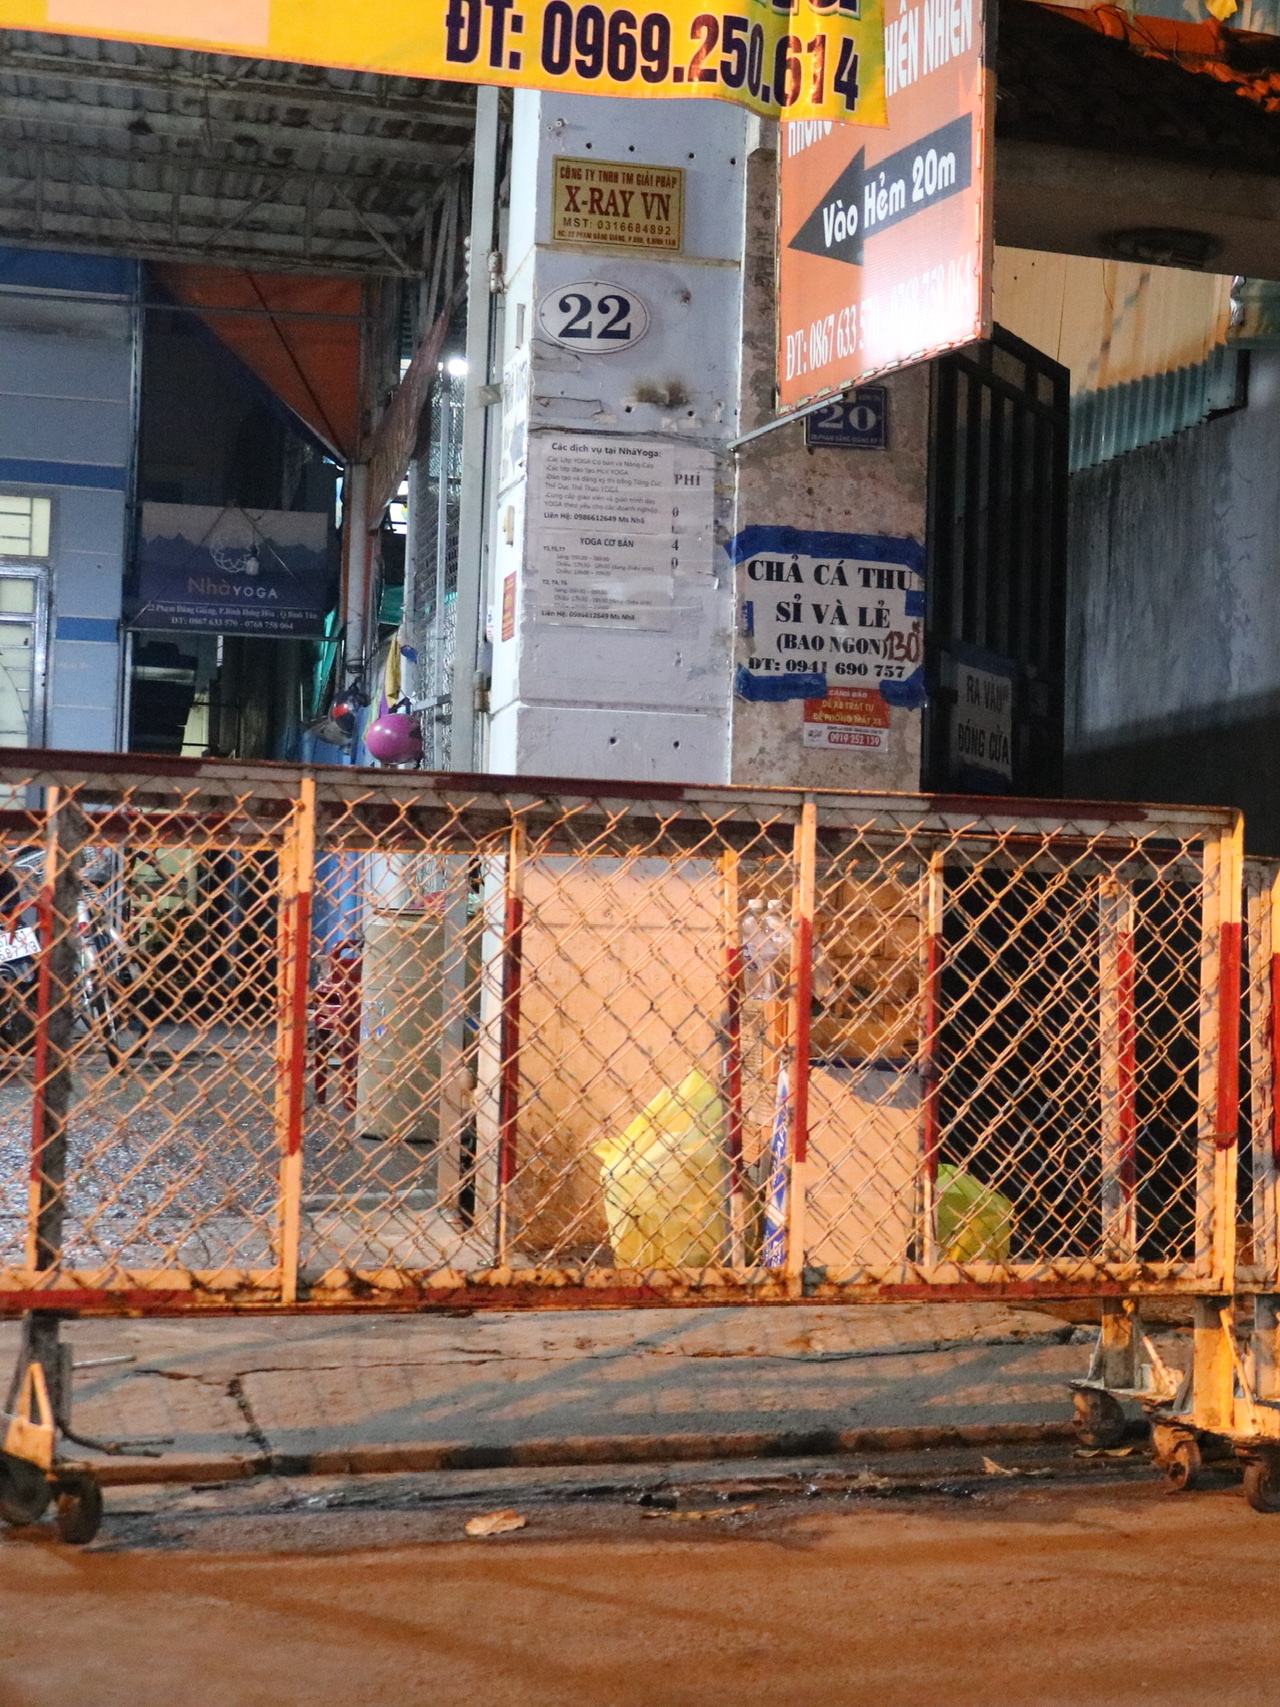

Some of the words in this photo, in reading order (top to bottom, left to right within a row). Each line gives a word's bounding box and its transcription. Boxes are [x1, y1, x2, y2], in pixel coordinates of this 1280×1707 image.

[541, 0, 860, 111] 0969.250.614
[560, 164, 582, 180] CÔNG
[585, 168, 596, 181] TY
[622, 172, 634, 185] TM
[564, 185, 635, 218] X-RAY
[641, 191, 671, 221] VN
[823, 200, 859, 248] Vào
[864, 171, 905, 229] Hẻm
[912, 149, 956, 203] 20m
[563, 217, 593, 229] MST:
[597, 219, 671, 236] 0316684892
[558, 293, 632, 340] 22
[809, 313, 835, 372] 0867
[837, 304, 858, 359] 633
[818, 403, 877, 431] 20
[552, 442, 567, 452] Các
[570, 443, 588, 454] dịch
[591, 446, 602, 455] vụ
[605, 446, 616, 456] tại
[580, 537, 602, 547] YOGA
[747, 554, 804, 583] CHẢ
[813, 560, 849, 587] CÁ
[858, 567, 913, 591] THU
[187, 576, 231, 596] Nhà
[232, 585, 278, 600] YOGA
[776, 593, 803, 623] SỈ
[811, 598, 849, 626] VÀ
[858, 600, 890, 629] LẺ
[776, 632, 825, 653] (BAO
[830, 636, 888, 660] NGON)
[748, 657, 781, 671] ĐT:
[786, 658, 827, 674] 0941
[835, 662, 868, 676] 690
[874, 664, 905, 679] 757
[850, 734, 864, 745] 252
[866, 735, 880, 746] 139
